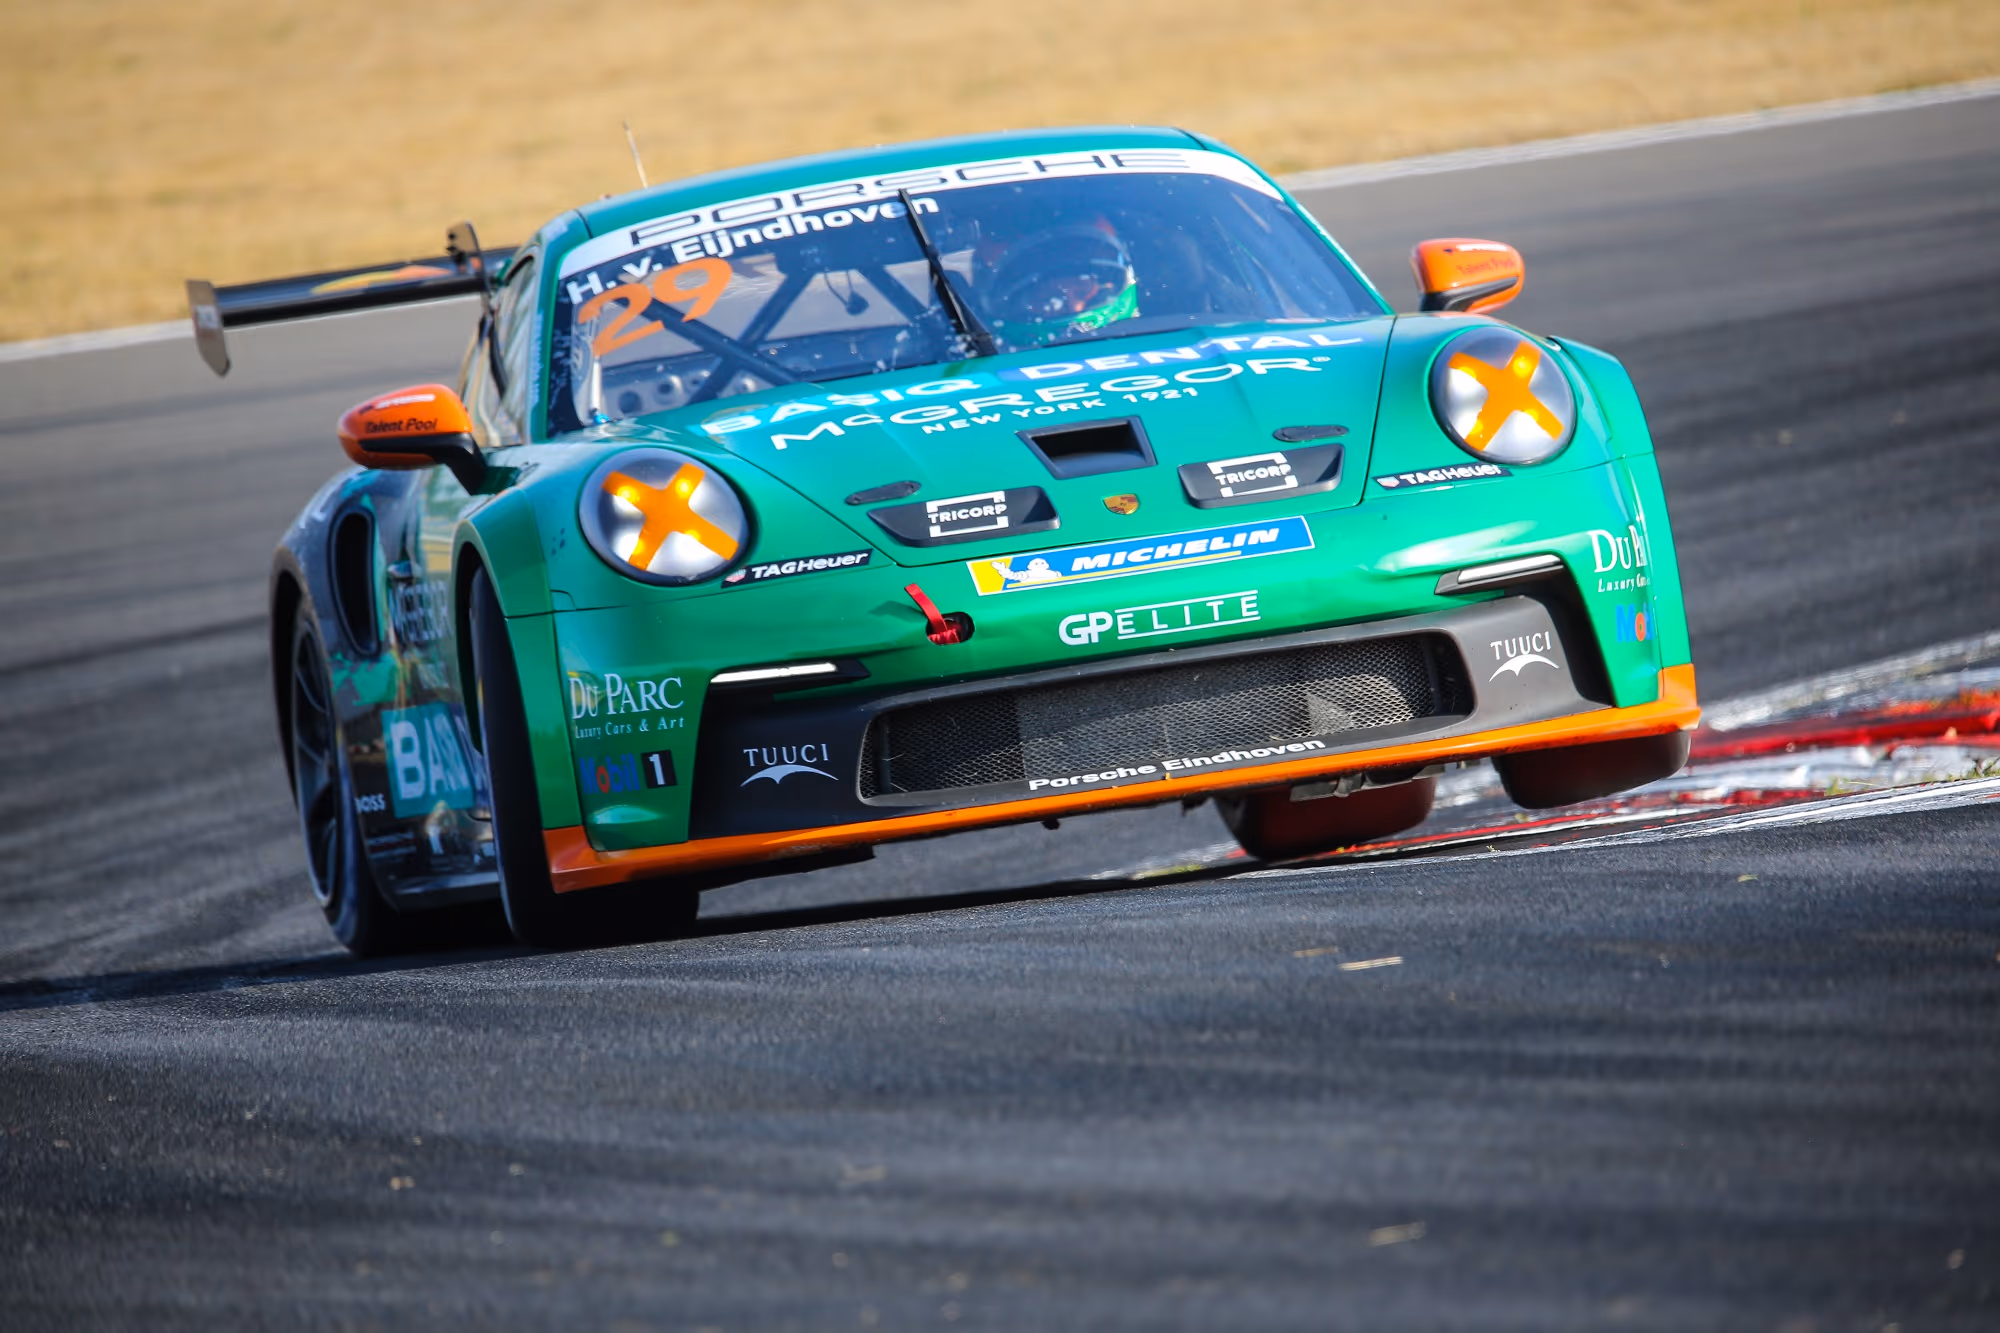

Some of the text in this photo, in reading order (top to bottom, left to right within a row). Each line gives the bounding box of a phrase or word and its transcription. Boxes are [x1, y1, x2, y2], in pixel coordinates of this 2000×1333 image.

[630, 152, 1190, 246] PORSCHE
[566, 195, 940, 304] H. v. Eijndhoven
[578, 257, 733, 358] 29
[700, 333, 1364, 436] BASIQ DENTAL
[365, 418, 438, 434] Talent Pool
[922, 386, 1198, 434] NEW YORK 1921
[1215, 464, 1292, 485] TRICORP
[928, 504, 1007, 524] TRICORP
[1071, 528, 1280, 571] MICHELIN
[1598, 577, 1634, 592] Luxury
[1490, 631, 1551, 660] TUUCI
[575, 716, 684, 739] Luxury Cars & Art
[579, 753, 666, 794] Mobil 1
[743, 743, 829, 767] TUUCI
[1028, 739, 1326, 791] Porsche Eindhoven
